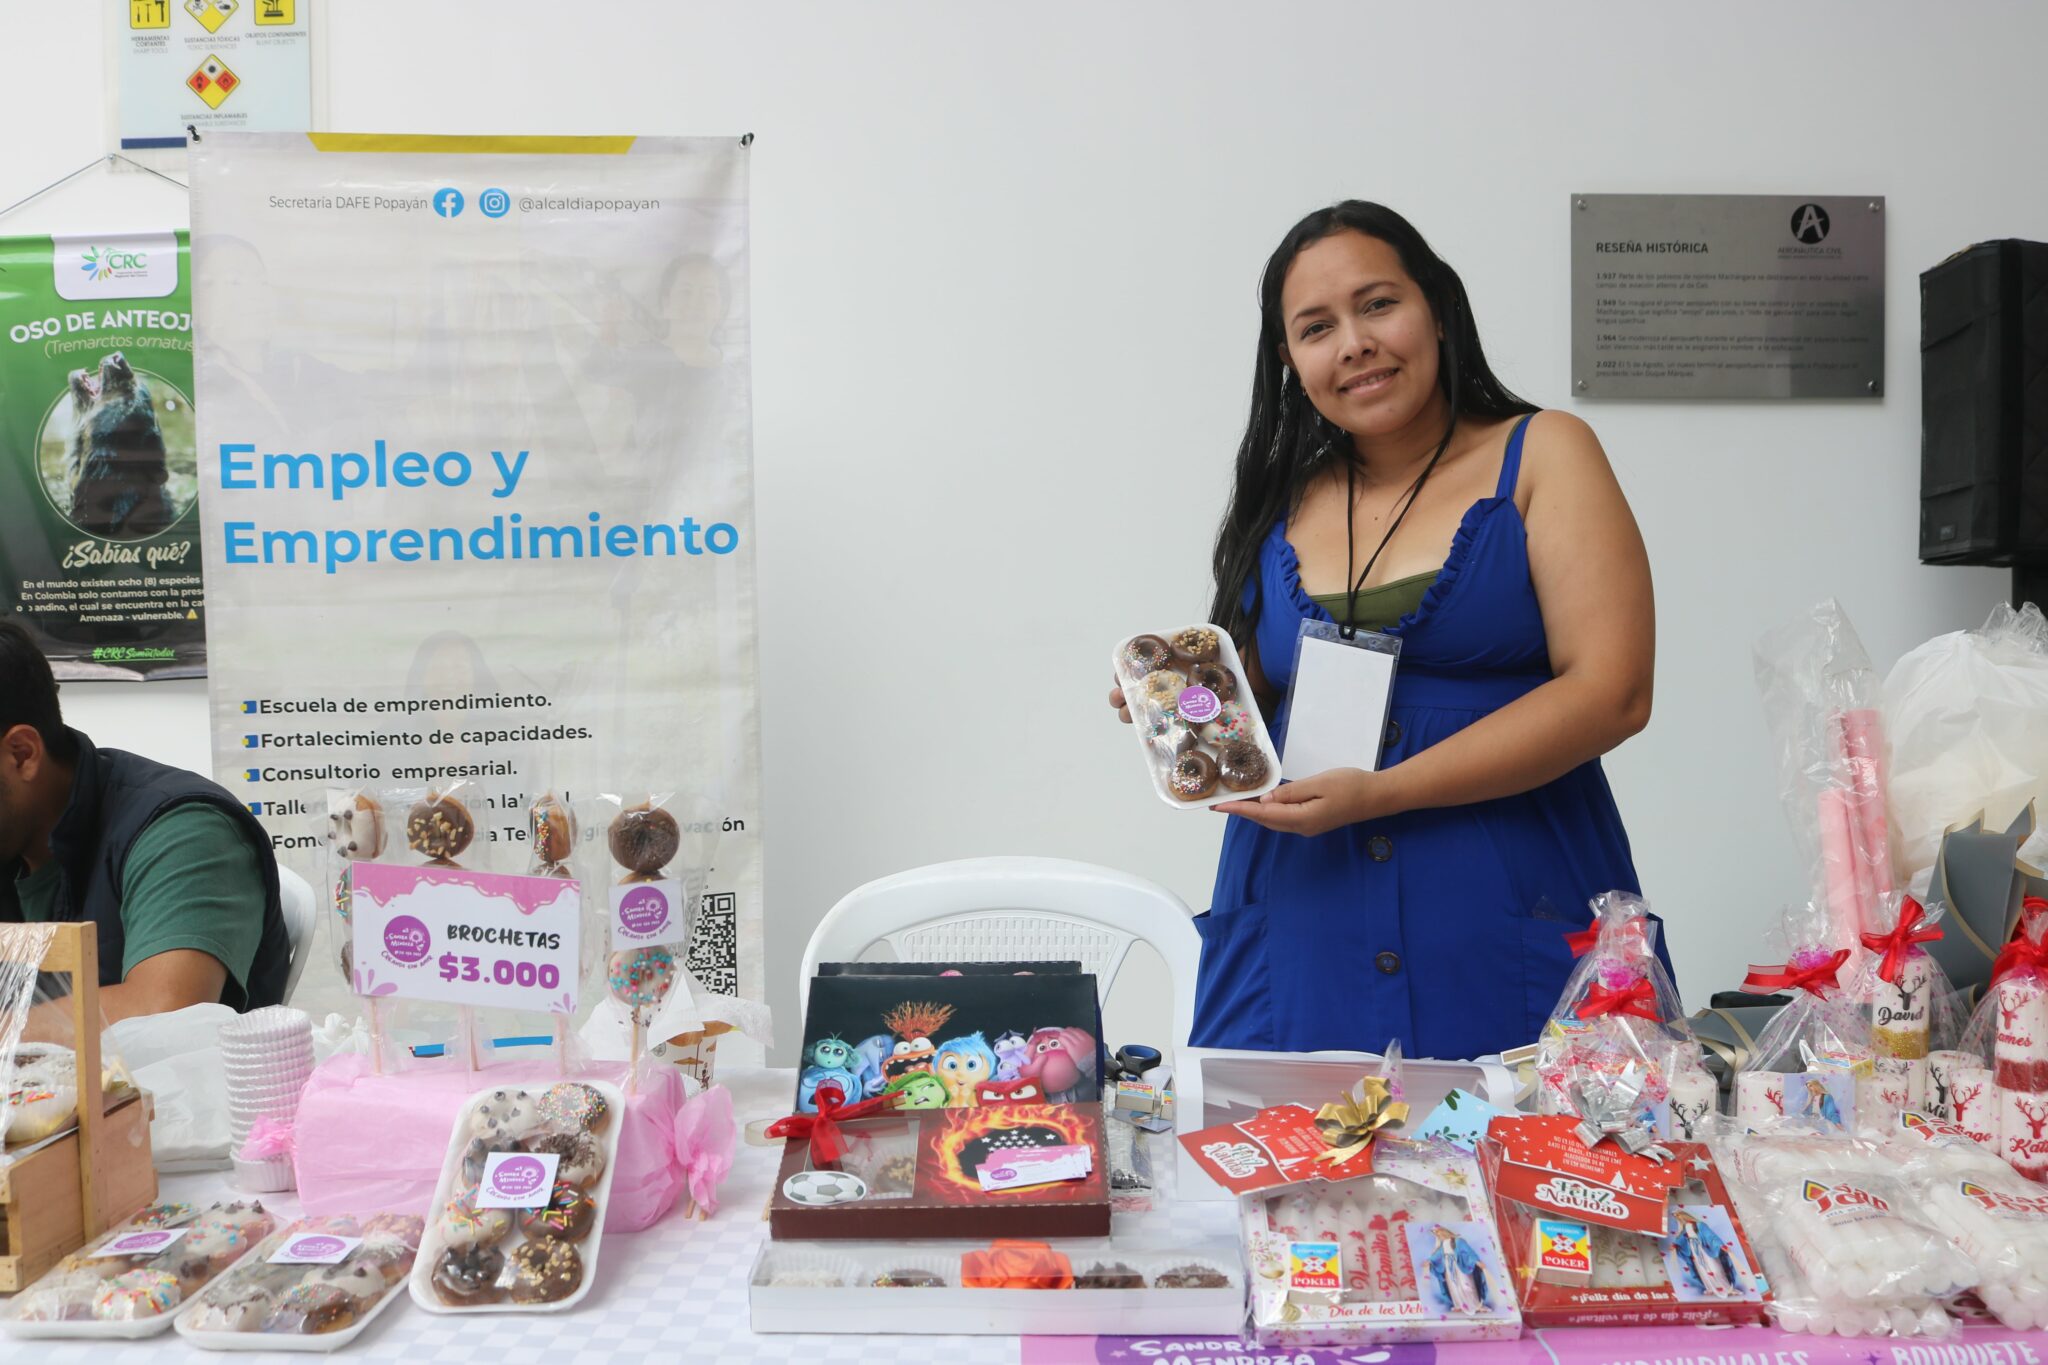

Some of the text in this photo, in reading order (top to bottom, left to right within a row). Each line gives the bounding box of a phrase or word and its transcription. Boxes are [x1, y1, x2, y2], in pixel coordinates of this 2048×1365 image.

[269, 195, 428, 212] Secretaría DAFE Popayán
[518, 196, 660, 212] @alcaldiapopayan
[1596, 239, 1709, 254] RESEÑA HISTÓRICA
[109, 253, 147, 269] CRC
[10, 309, 193, 343] OSO DE ANTEOJ
[44, 334, 133, 359] (Tremarctos
[219, 439, 530, 500] Empleo y
[223, 511, 739, 574] Emprendimiento
[62, 540, 191, 569] ¿Sabías qué?
[23, 575, 200, 589] En el mundo existen ocho (8) especies
[21, 592, 33, 600] En
[35, 591, 77, 600] Colombia
[78, 590, 98, 599] solo
[101, 590, 148, 598] contamos
[150, 589, 168, 597] con
[170, 587, 179, 596] la
[34, 602, 68, 612] andino,
[69, 602, 78, 611] el
[79, 602, 99, 611] cual
[101, 602, 113, 610] se
[114, 600, 164, 610] encuentra
[166, 600, 178, 608] en
[181, 599, 189, 607] la
[80, 613, 124, 622] Amenaza
[132, 611, 185, 621] vulnerable.
[259, 693, 552, 715] Escuela de emprendimiento.
[261, 725, 593, 748] Fortalecimiento de capacidades.
[262, 760, 518, 782] Consultorio empresarial.
[447, 924, 561, 950] BROCHETAS
[438, 951, 560, 990] $3.000
[1878, 1005, 1925, 1026] David
[1996, 1030, 2033, 1048] ames
[1555, 1181, 1610, 1203] Feliz
[1541, 1186, 1625, 1217] Navidad
[1543, 1255, 1586, 1269] POKER
[1293, 1277, 1336, 1287] POKER
[1611, 1292, 1631, 1301] día
[1633, 1291, 1649, 1301] de
[1651, 1290, 1669, 1300] las
[1328, 1304, 1353, 1318] Día
[1358, 1305, 1374, 1316] de
[1379, 1303, 1395, 1316] las
[1129, 1340, 1265, 1356] SANDRA
[1602, 1349, 1810, 1365] IVIDUALES
[1891, 1341, 2041, 1365] BOUQUETE
